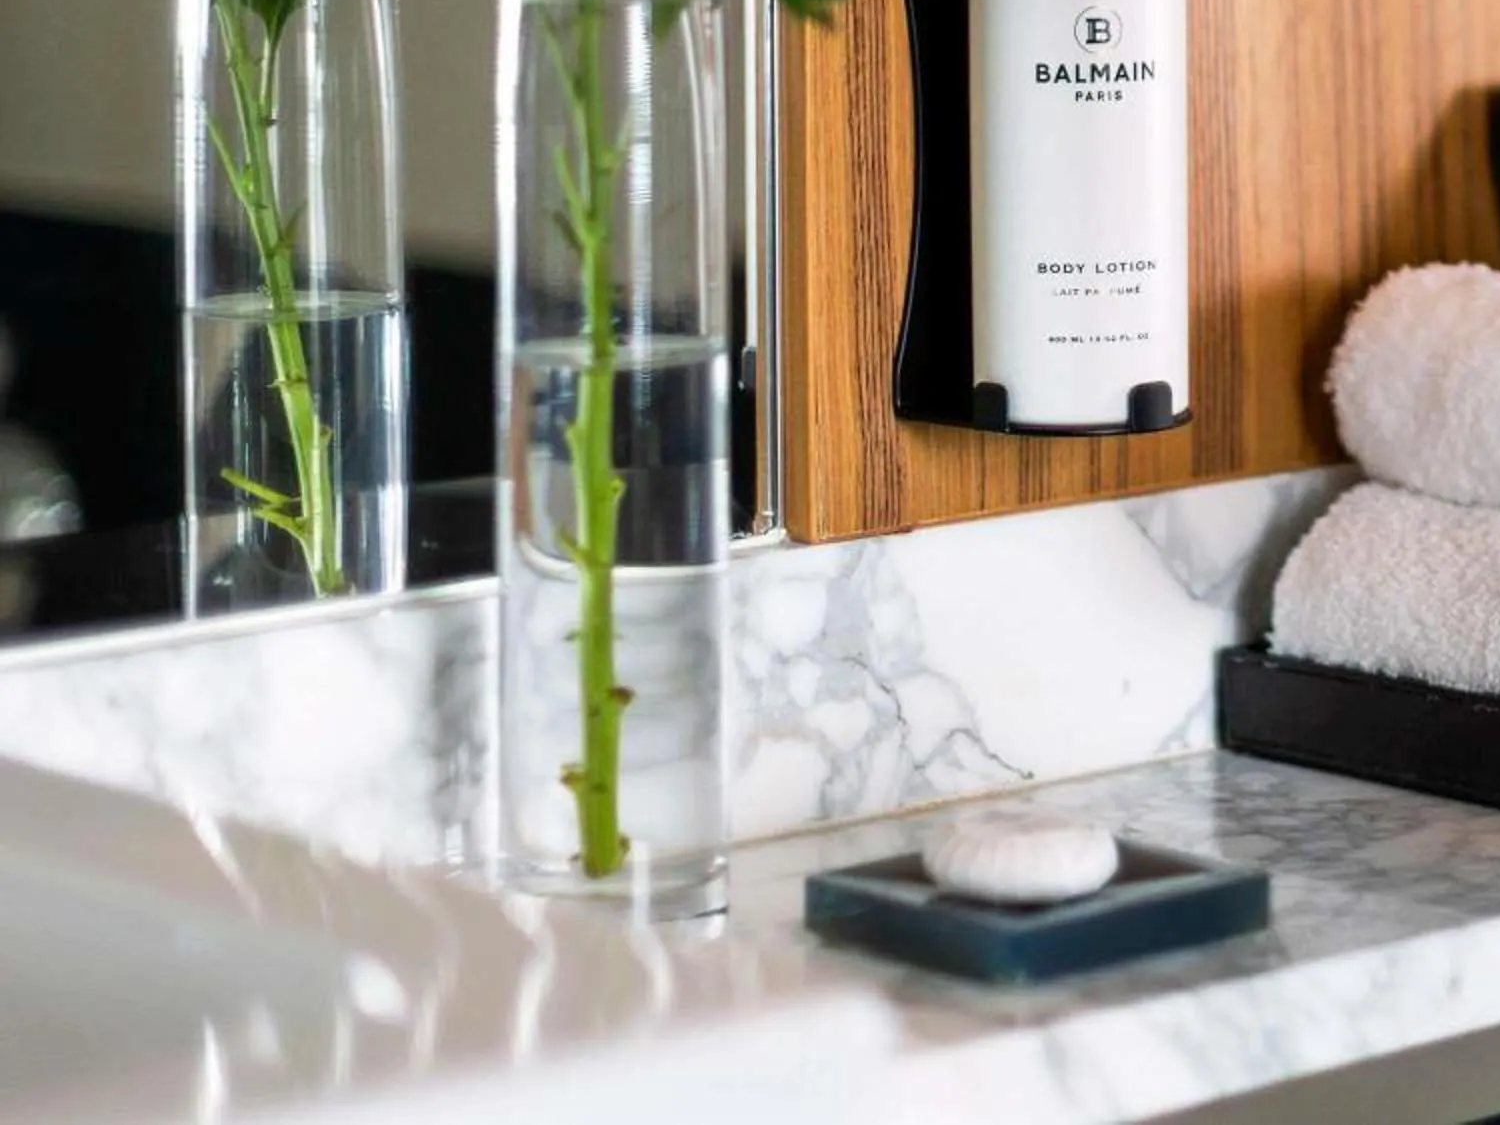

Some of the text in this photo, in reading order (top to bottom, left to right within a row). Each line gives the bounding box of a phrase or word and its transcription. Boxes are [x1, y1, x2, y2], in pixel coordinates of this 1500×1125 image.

[1035, 60, 1155, 84] BALMAIN
[1075, 90, 1124, 102] PARIS
[1037, 260, 1157, 275] BODY LOTION
